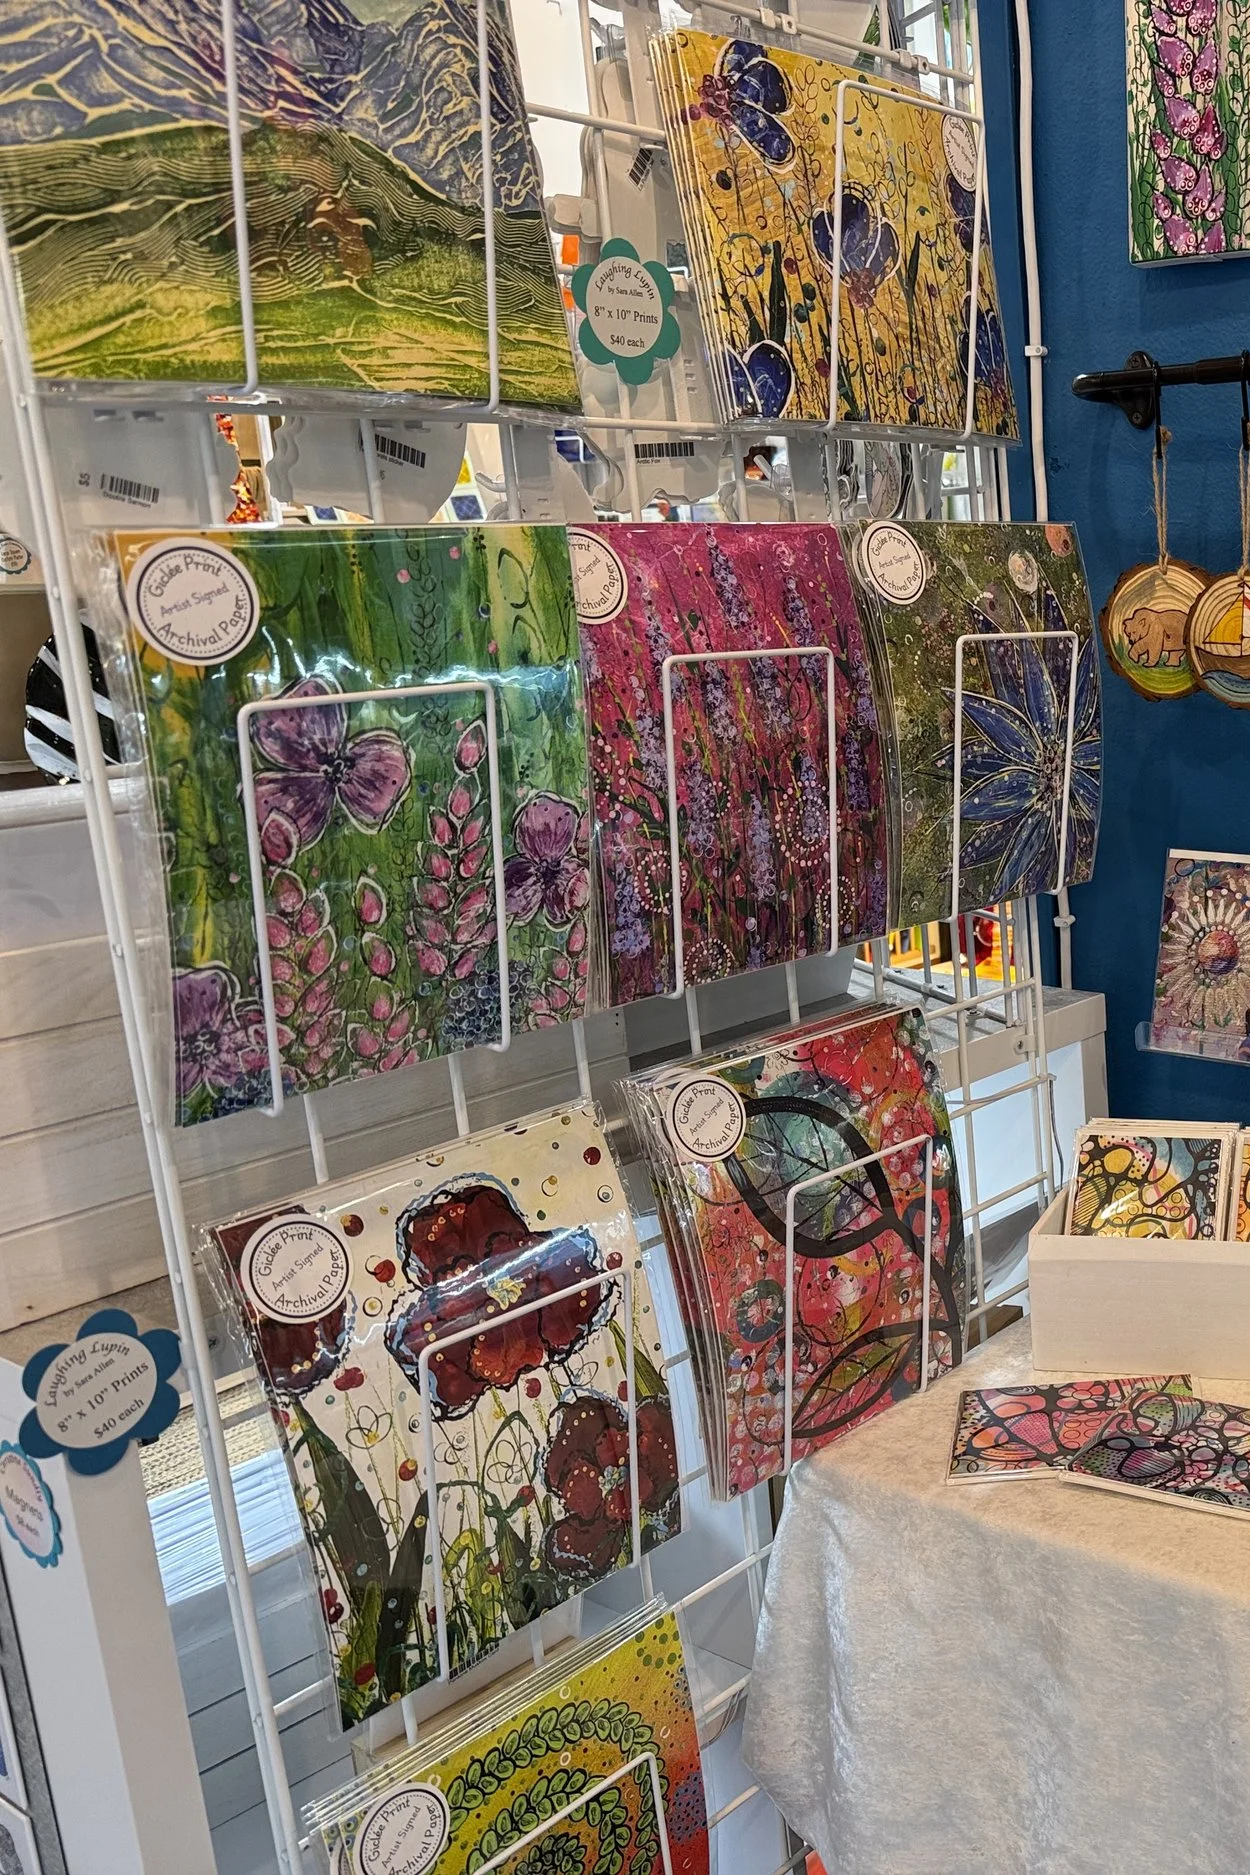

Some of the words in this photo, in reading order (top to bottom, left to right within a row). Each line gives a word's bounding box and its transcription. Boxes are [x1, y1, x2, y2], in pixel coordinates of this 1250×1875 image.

[595, 261, 631, 292] Laughing
[634, 271, 654, 300] Lupin
[608, 286, 615, 294] by
[616, 287, 628, 295] Sara
[629, 289, 643, 297] Allen
[634, 311, 658, 324] Prints
[610, 335, 625, 345] $40
[627, 338, 645, 348] each
[888, 531, 906, 547] Print
[184, 554, 222, 577] Print
[579, 555, 600, 577] Signed
[604, 562, 619, 594] Paper
[878, 573, 910, 591] Archival
[908, 561, 920, 586] Paper
[160, 599, 192, 617] Artist
[191, 581, 229, 605] Signed
[159, 623, 222, 647] Archival
[219, 594, 247, 636] Paper
[692, 1087, 716, 1098] Print
[690, 1118, 707, 1136] Artist
[704, 1097, 725, 1119] Signed
[692, 1131, 730, 1150] Archival
[725, 1101, 739, 1131] Paper
[279, 1230, 313, 1245] Print
[272, 1269, 297, 1291] Artist
[295, 1243, 324, 1269] Signed
[274, 1284, 328, 1308] Archival
[322, 1249, 344, 1286] Paper
[45, 1349, 88, 1407] Laughing
[90, 1341, 130, 1356] Lupin
[63, 1387, 74, 1398] by
[75, 1375, 93, 1388] Sara
[93, 1358, 115, 1375] Allen
[78, 1410, 87, 1420] x
[111, 1362, 148, 1392] Prints
[94, 1418, 116, 1438] $40
[120, 1399, 144, 1421] each
[380, 1797, 410, 1822] Print
[425, 1804, 441, 1838] Paper
[382, 1840, 402, 1868] Artist
[398, 1806, 421, 1838] Signed
